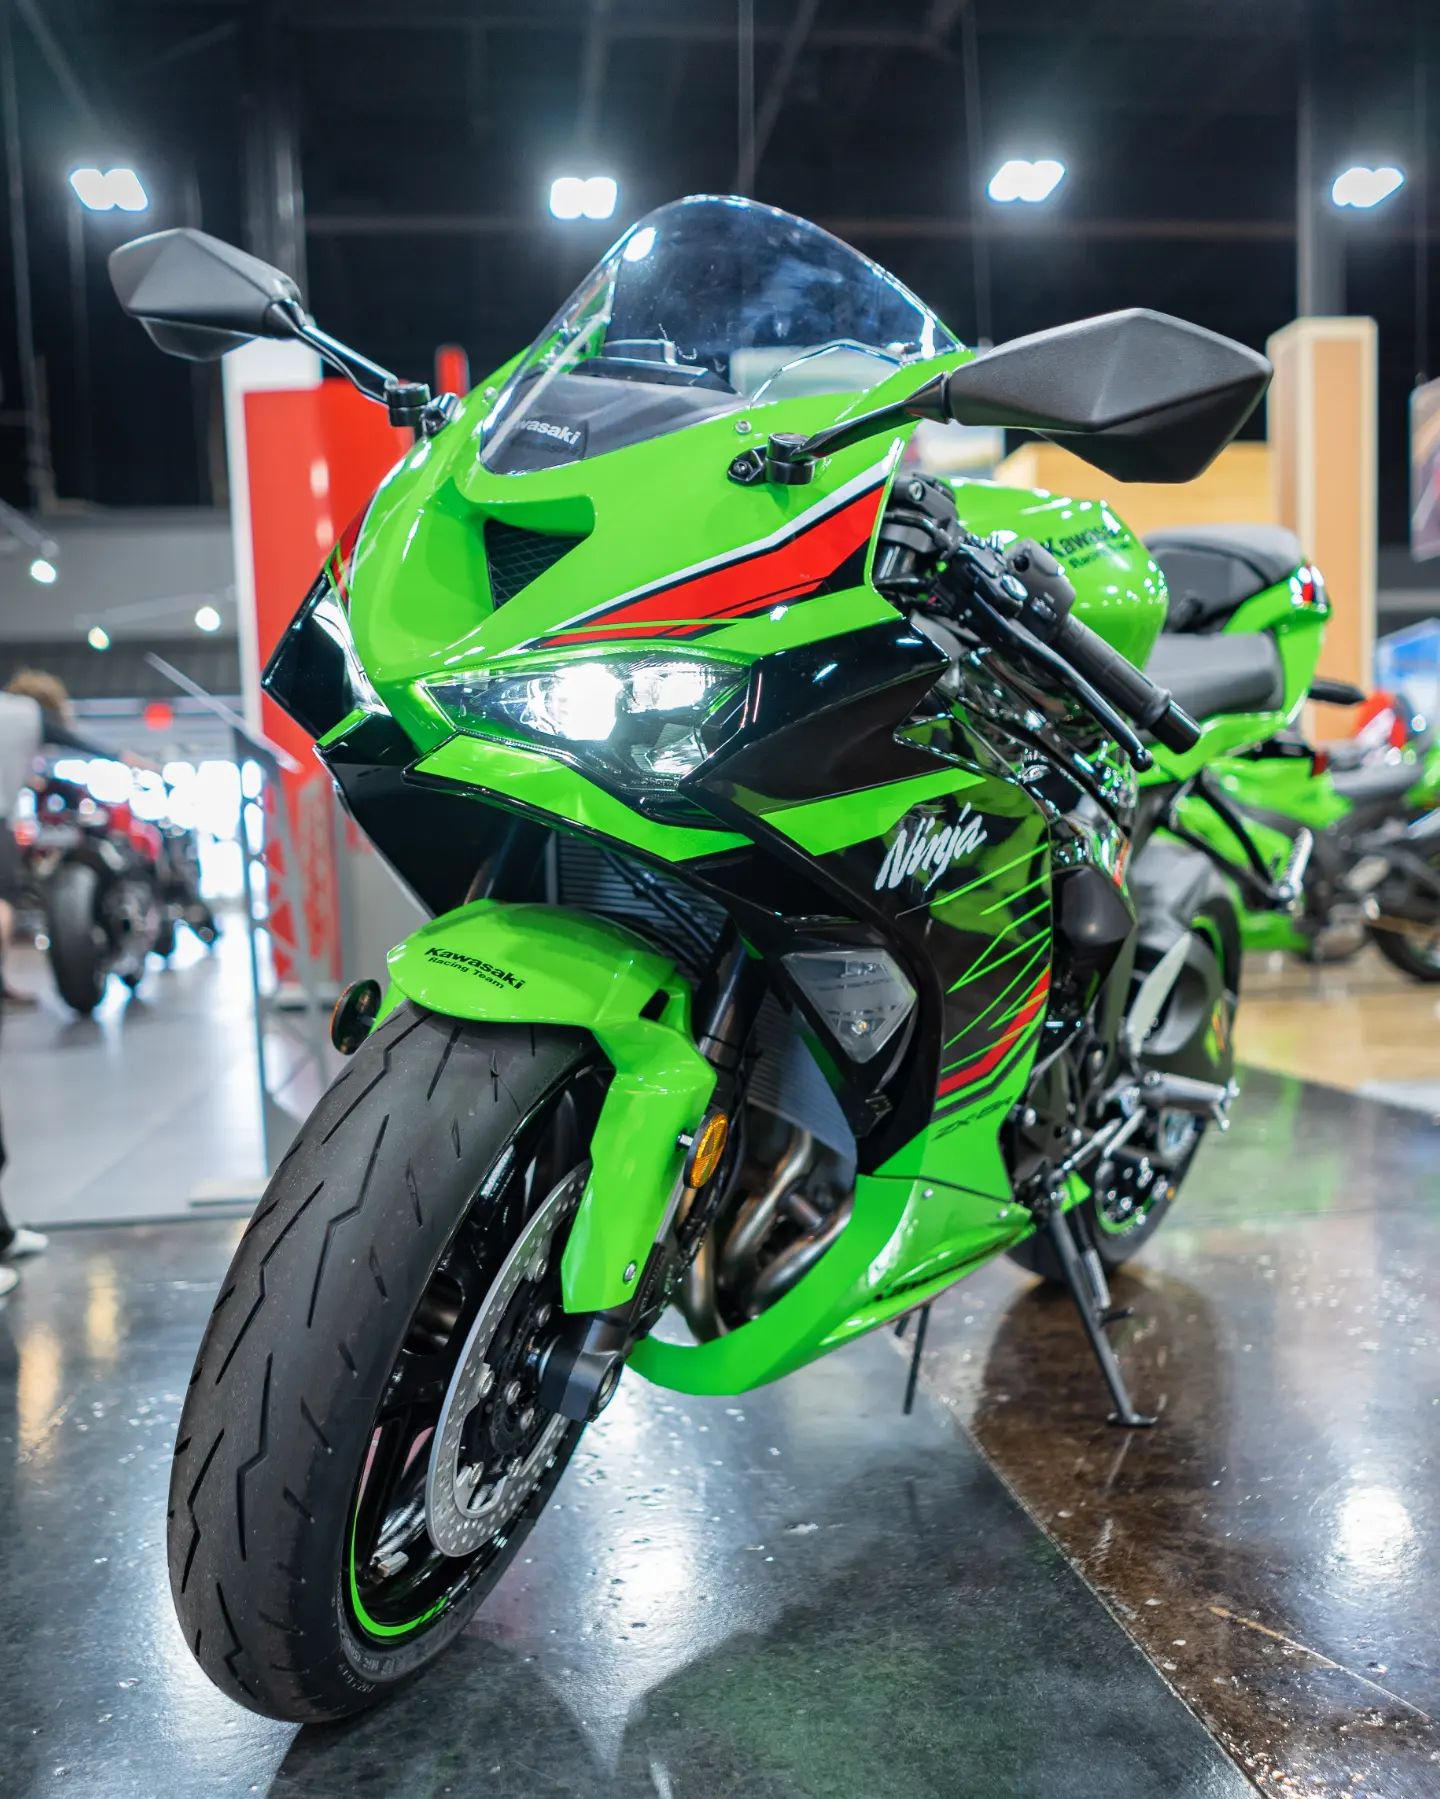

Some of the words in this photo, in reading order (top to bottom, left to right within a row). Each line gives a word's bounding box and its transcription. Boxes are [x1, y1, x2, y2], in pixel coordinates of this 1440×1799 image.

[874, 801, 988, 892] Ninja
[424, 947, 526, 990] Kawasaki
[427, 956, 470, 973] Racing
[472, 969, 505, 989] Team
